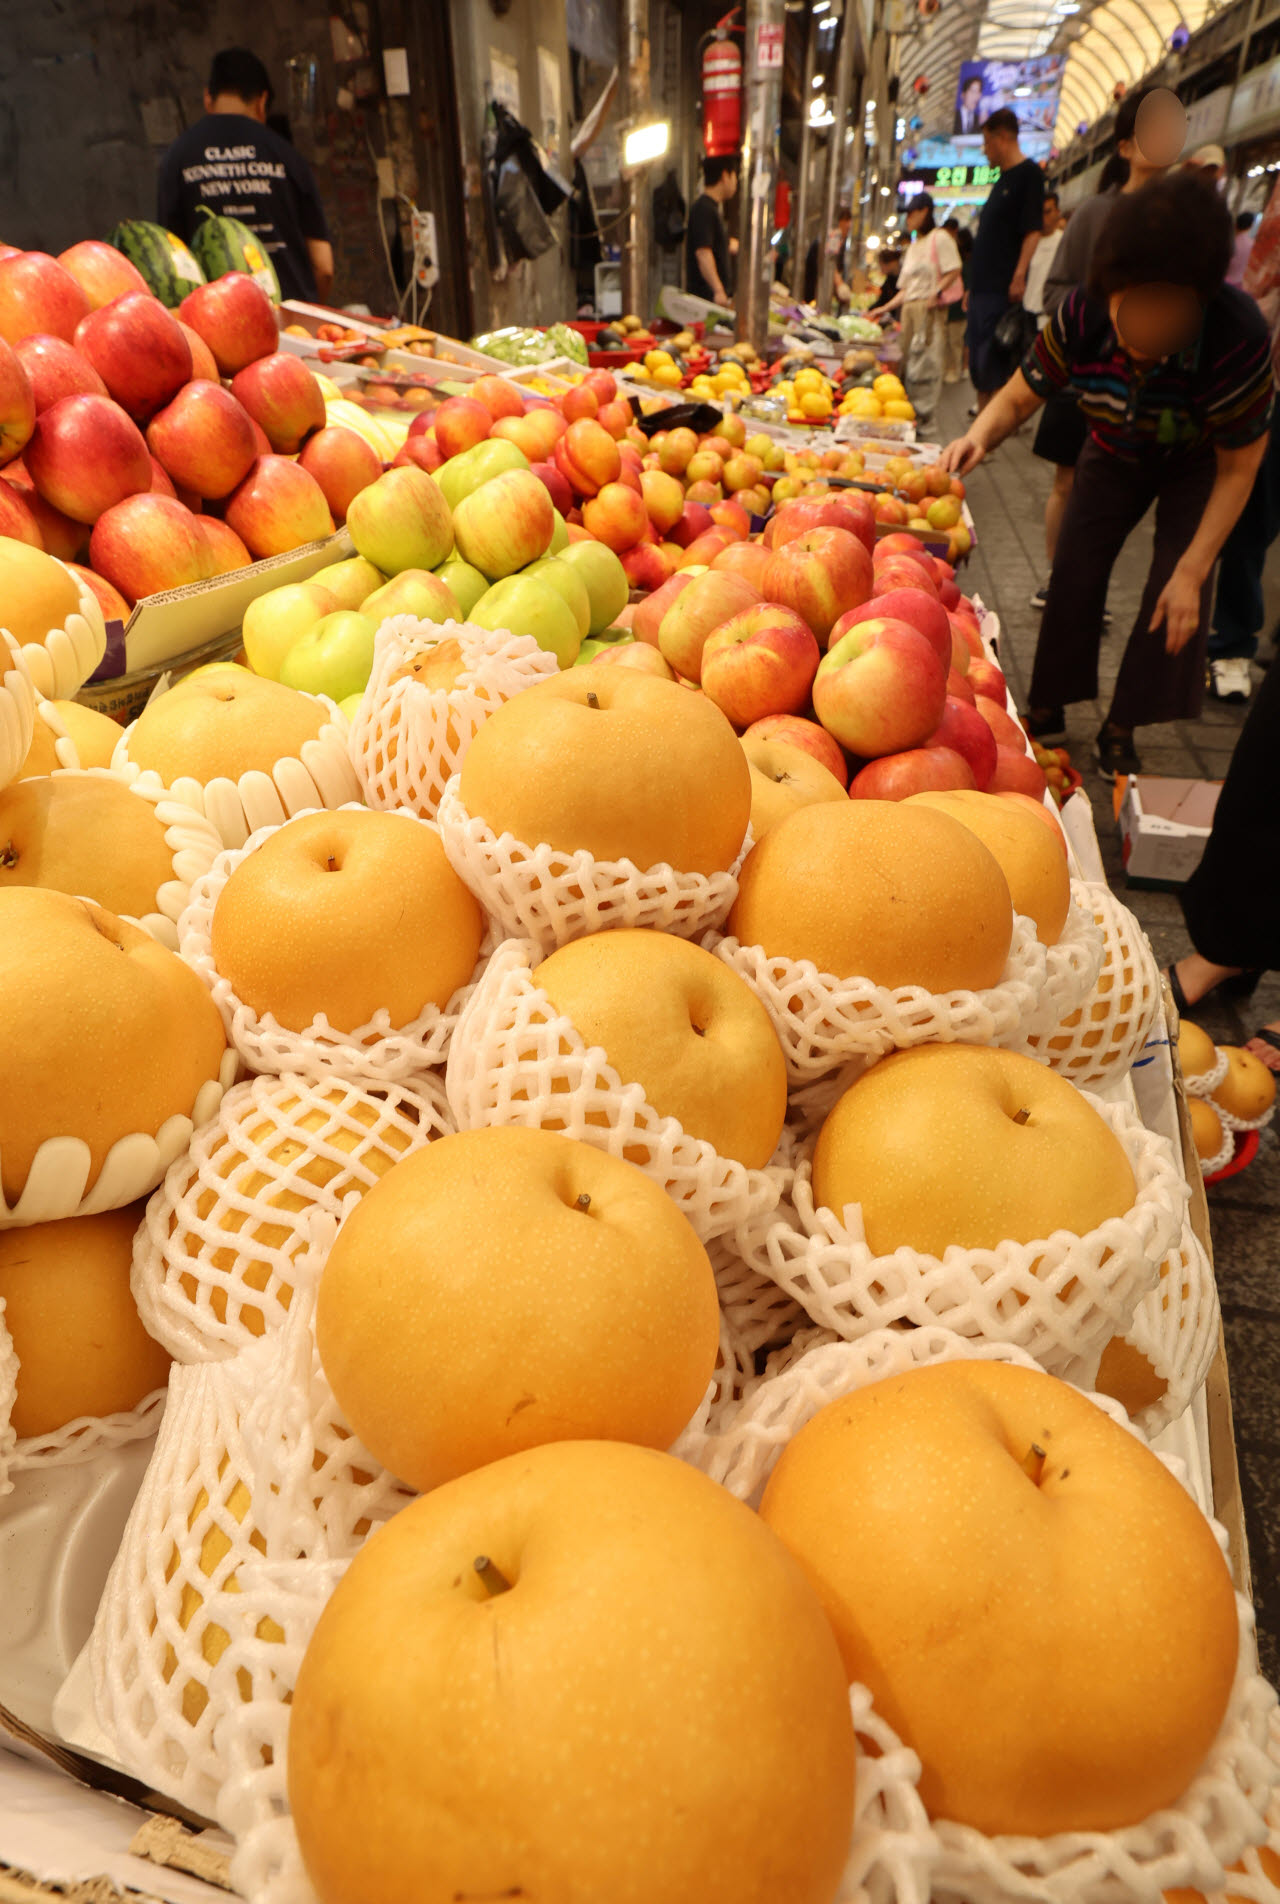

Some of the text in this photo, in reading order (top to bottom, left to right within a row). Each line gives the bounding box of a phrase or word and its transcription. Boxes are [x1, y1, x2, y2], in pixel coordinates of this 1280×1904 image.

[204, 145, 256, 160] CLASIC
[182, 161, 286, 183] KENNETH COLE
[200, 179, 271, 197] NEW YORK
